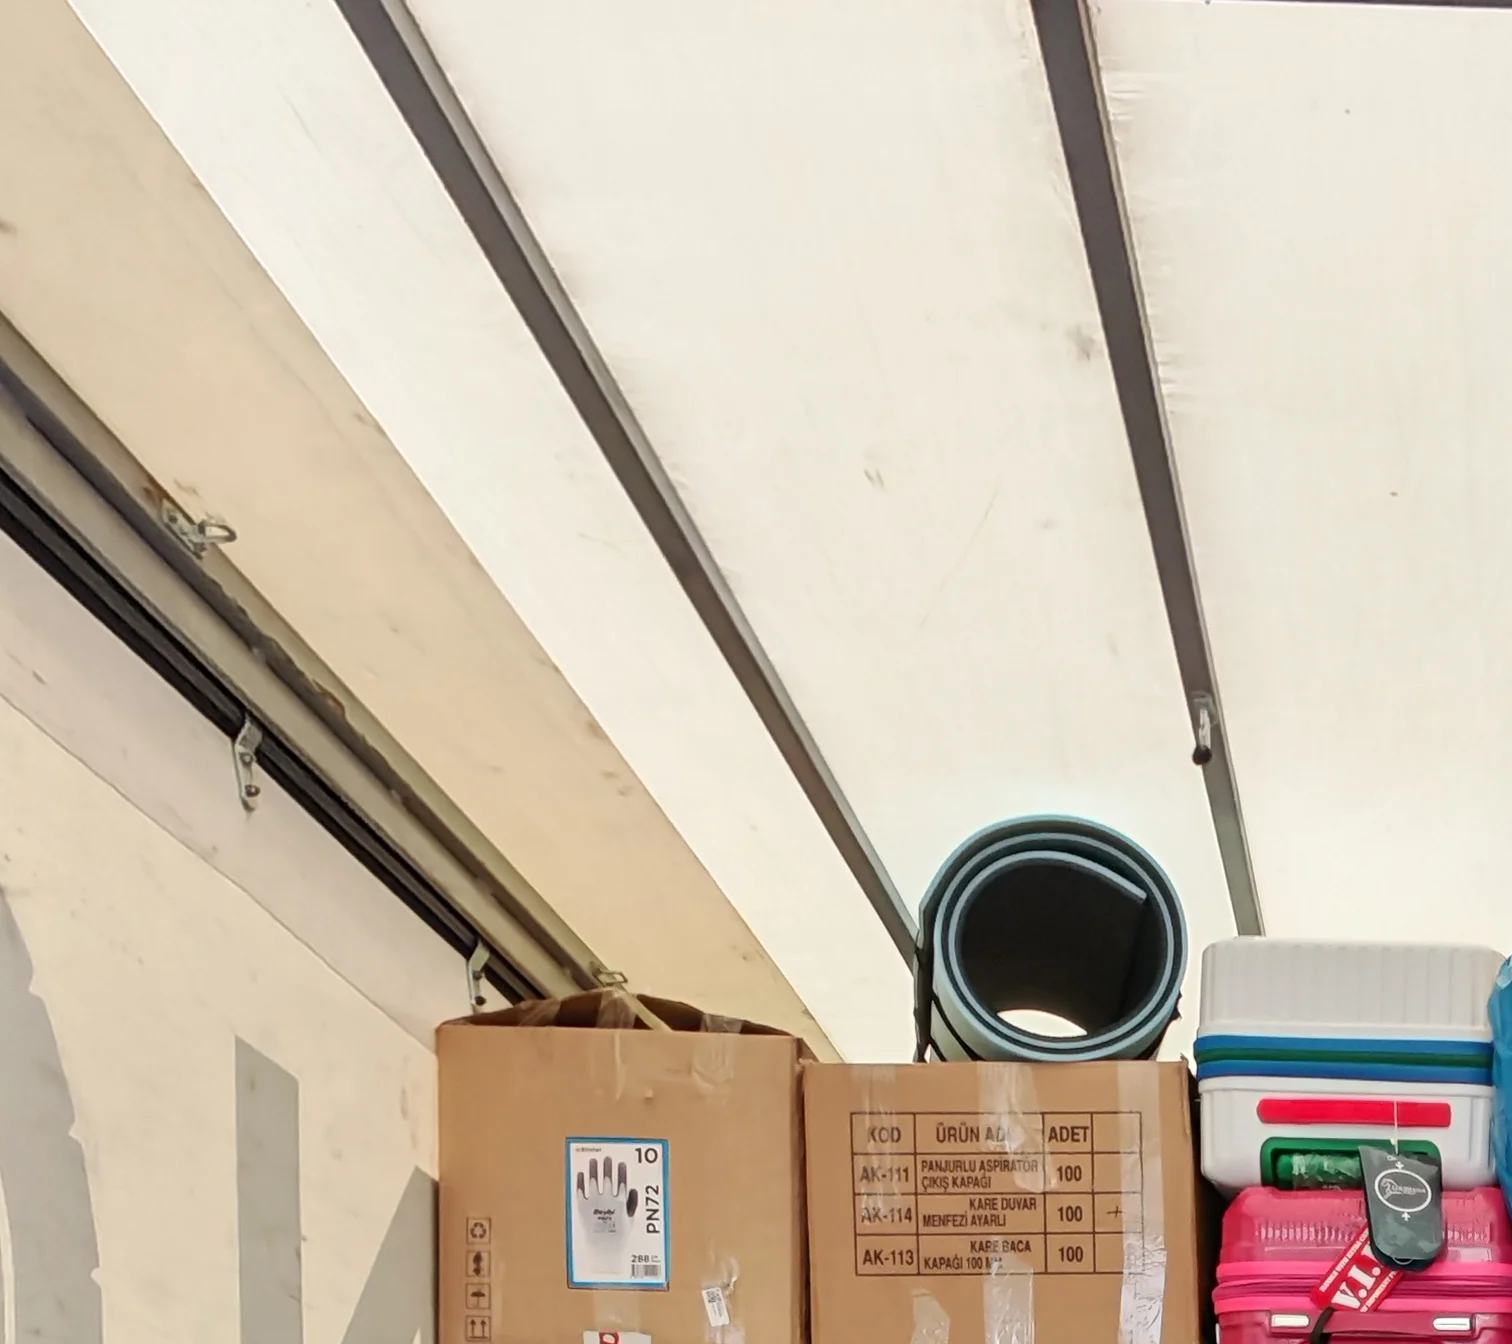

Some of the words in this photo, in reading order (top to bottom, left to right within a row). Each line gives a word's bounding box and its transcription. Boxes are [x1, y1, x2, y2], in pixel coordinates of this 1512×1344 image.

[868, 1126, 901, 1143] KOD
[936, 1122, 980, 1143] ÜRÜN
[1048, 1126, 1089, 1143] ADET
[635, 1147, 658, 1164] 10
[860, 1165, 909, 1183] AK-111
[921, 1160, 976, 1173] PANJURLU
[1057, 1165, 1082, 1182] 100
[922, 1176, 950, 1192] ÇIKIŞ
[951, 1173, 992, 1189] KAPAĞI
[646, 1184, 660, 1234] PN72
[969, 1198, 998, 1211] KARE
[1001, 1198, 1037, 1211] DUVAR
[861, 1206, 913, 1223] AK-114
[923, 1211, 968, 1227] MENFEZİ
[971, 1213, 1006, 1227] AYARLI
[1057, 1205, 1083, 1222] 100
[863, 1249, 915, 1266] AK-113
[1058, 1246, 1084, 1263] 100
[970, 1240, 998, 1253] KARE
[1002, 1240, 1032, 1253] BACA
[631, 1255, 650, 1263] 288
[924, 1252, 963, 1269] KAPAĞI
[965, 1256, 983, 1269] 100
